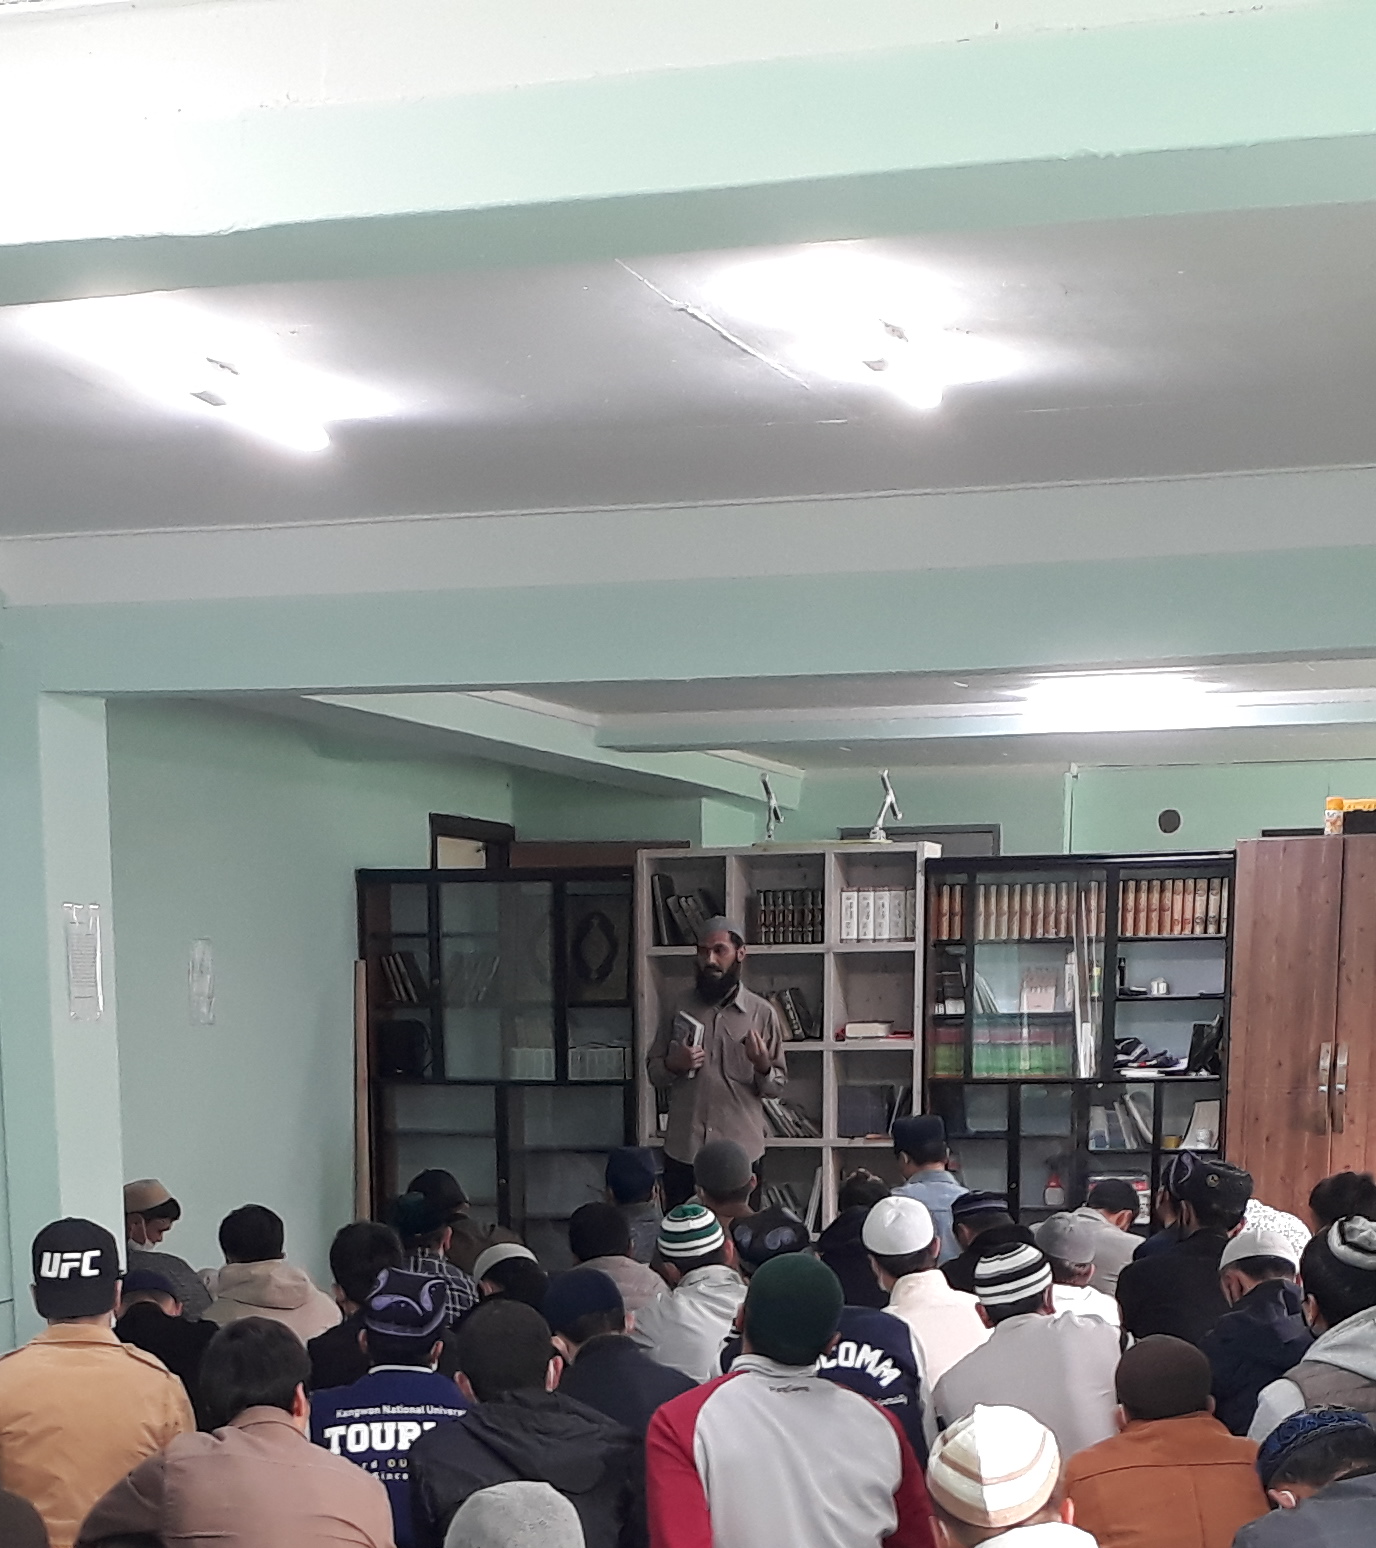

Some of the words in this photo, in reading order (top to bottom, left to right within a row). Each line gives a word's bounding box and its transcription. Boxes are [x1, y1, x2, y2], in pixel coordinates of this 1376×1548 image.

[40, 1250, 101, 1279] UFC
[815, 1341, 902, 1387] COMM
[382, 1404, 425, 1415] National
[324, 1421, 437, 1455] TOUR
